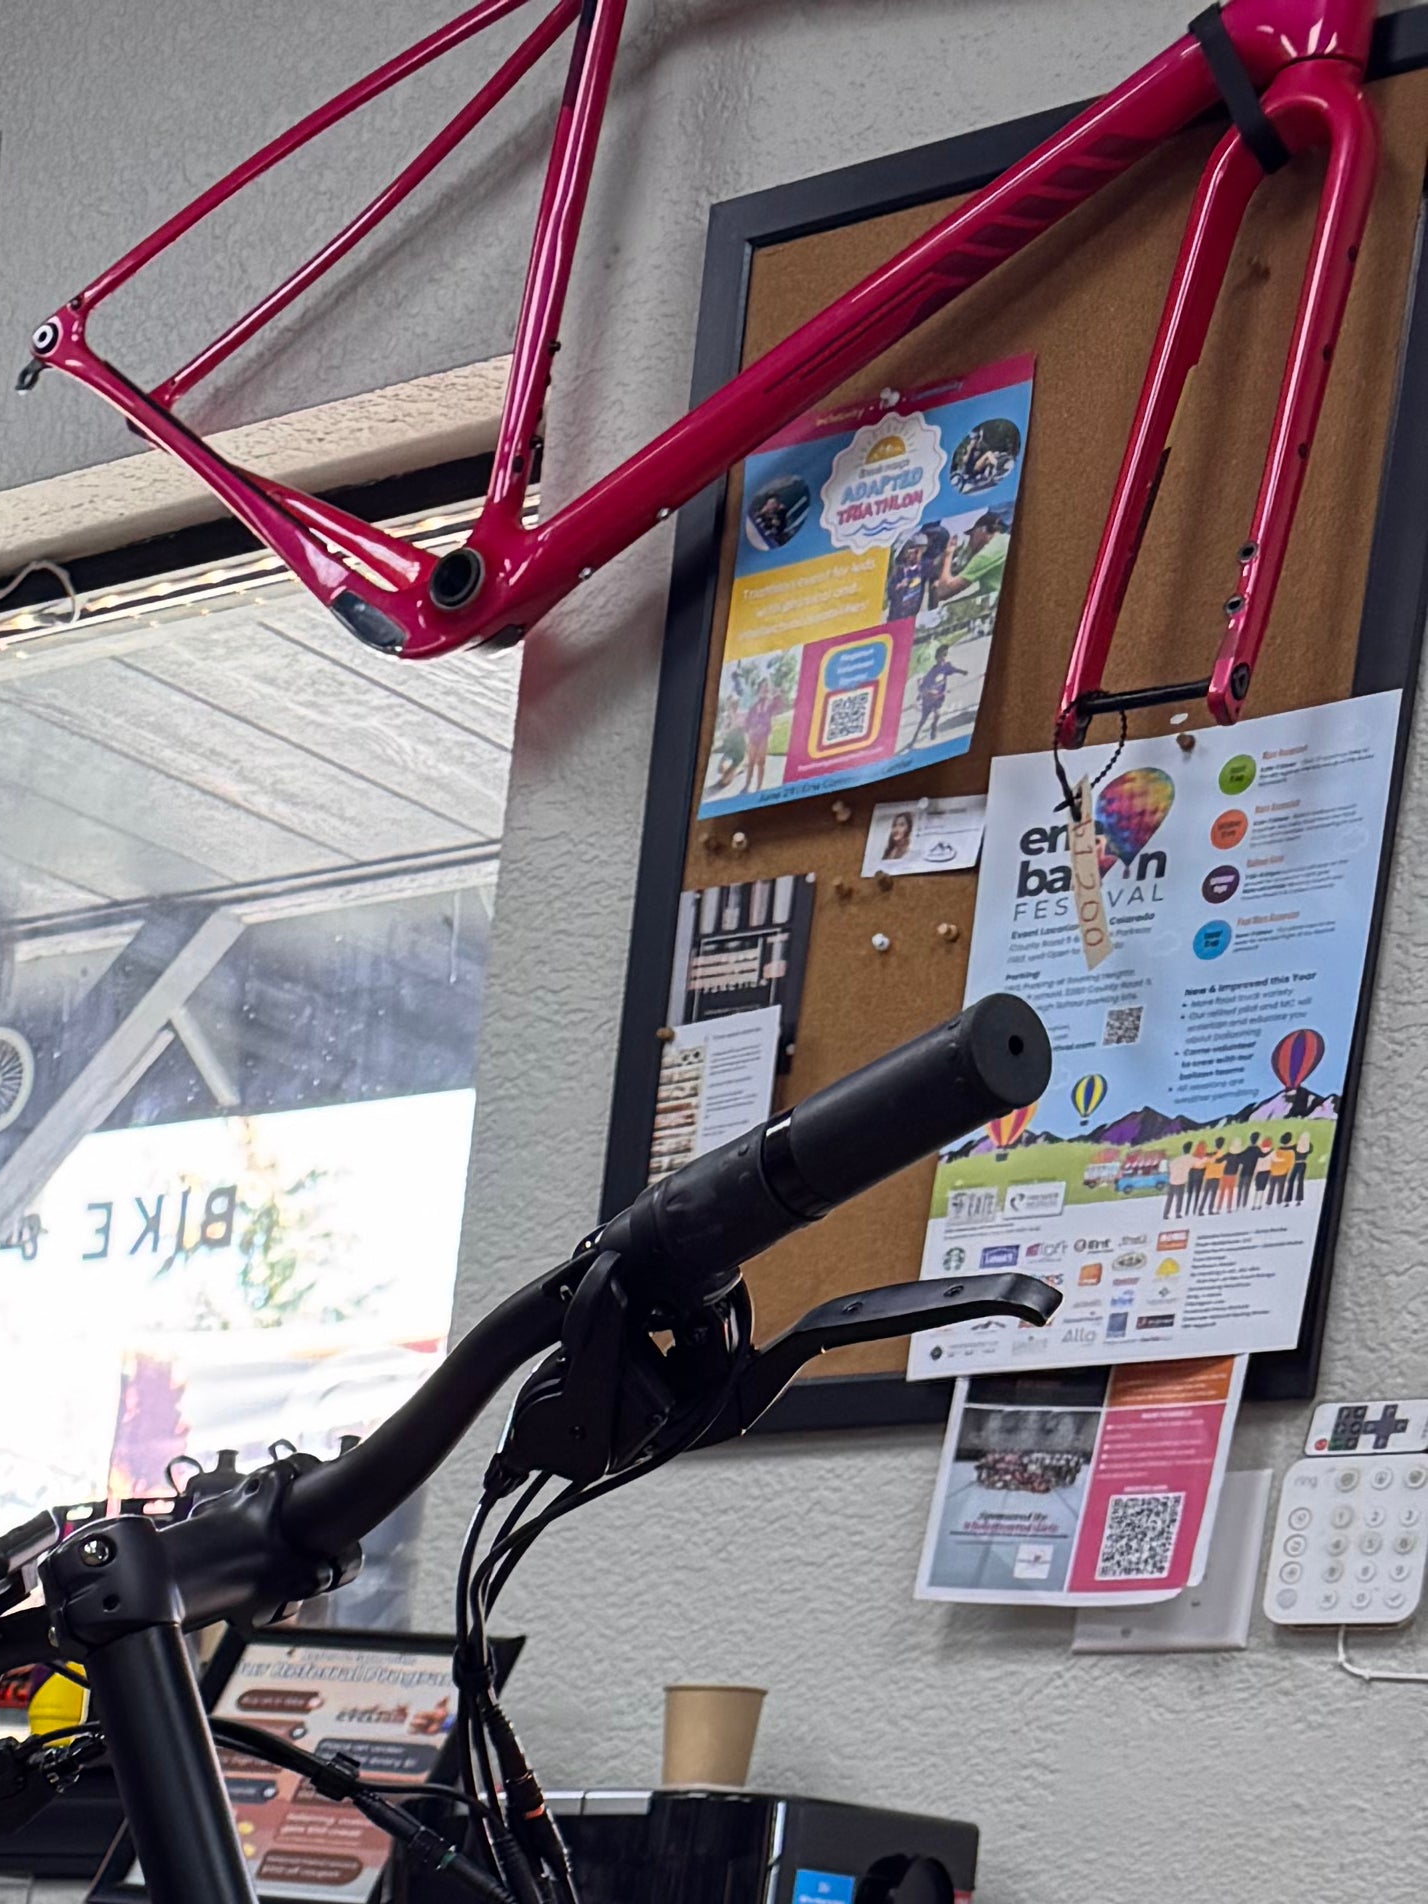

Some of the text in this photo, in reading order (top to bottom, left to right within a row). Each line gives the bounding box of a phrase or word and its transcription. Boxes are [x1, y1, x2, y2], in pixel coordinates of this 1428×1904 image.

[840, 466, 924, 505] ADAPTED
[836, 490, 925, 526] TRIATHLON
[1012, 884, 1165, 922] FESVAL
